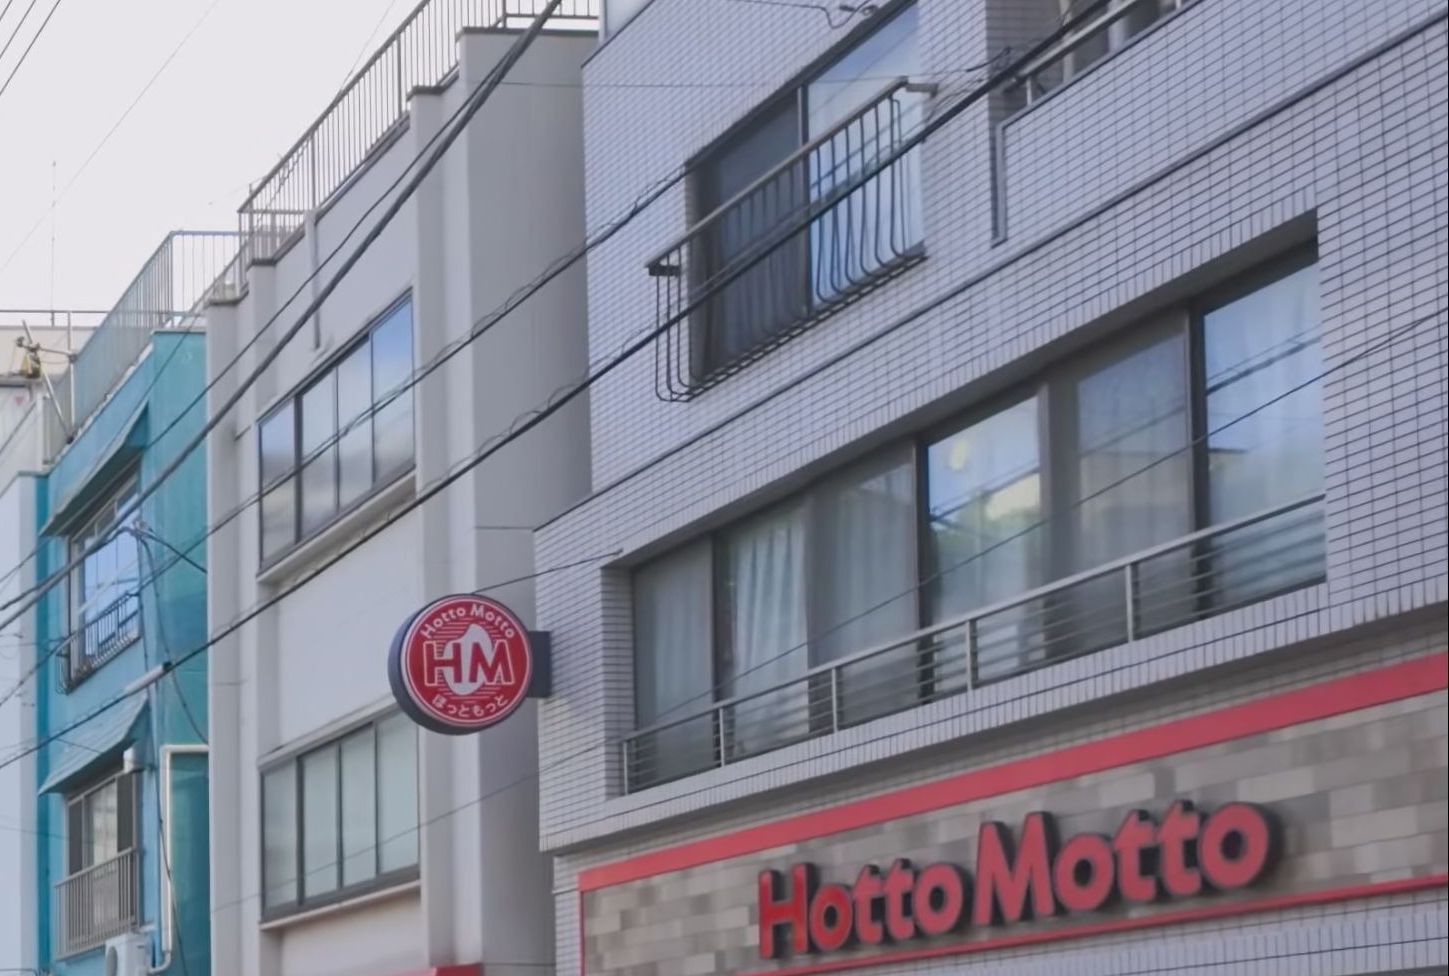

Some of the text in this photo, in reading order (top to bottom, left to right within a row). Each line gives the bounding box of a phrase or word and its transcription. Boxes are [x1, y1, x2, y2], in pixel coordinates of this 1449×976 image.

[421, 604, 515, 638] Hotto Motto
[422, 638, 516, 687] HM
